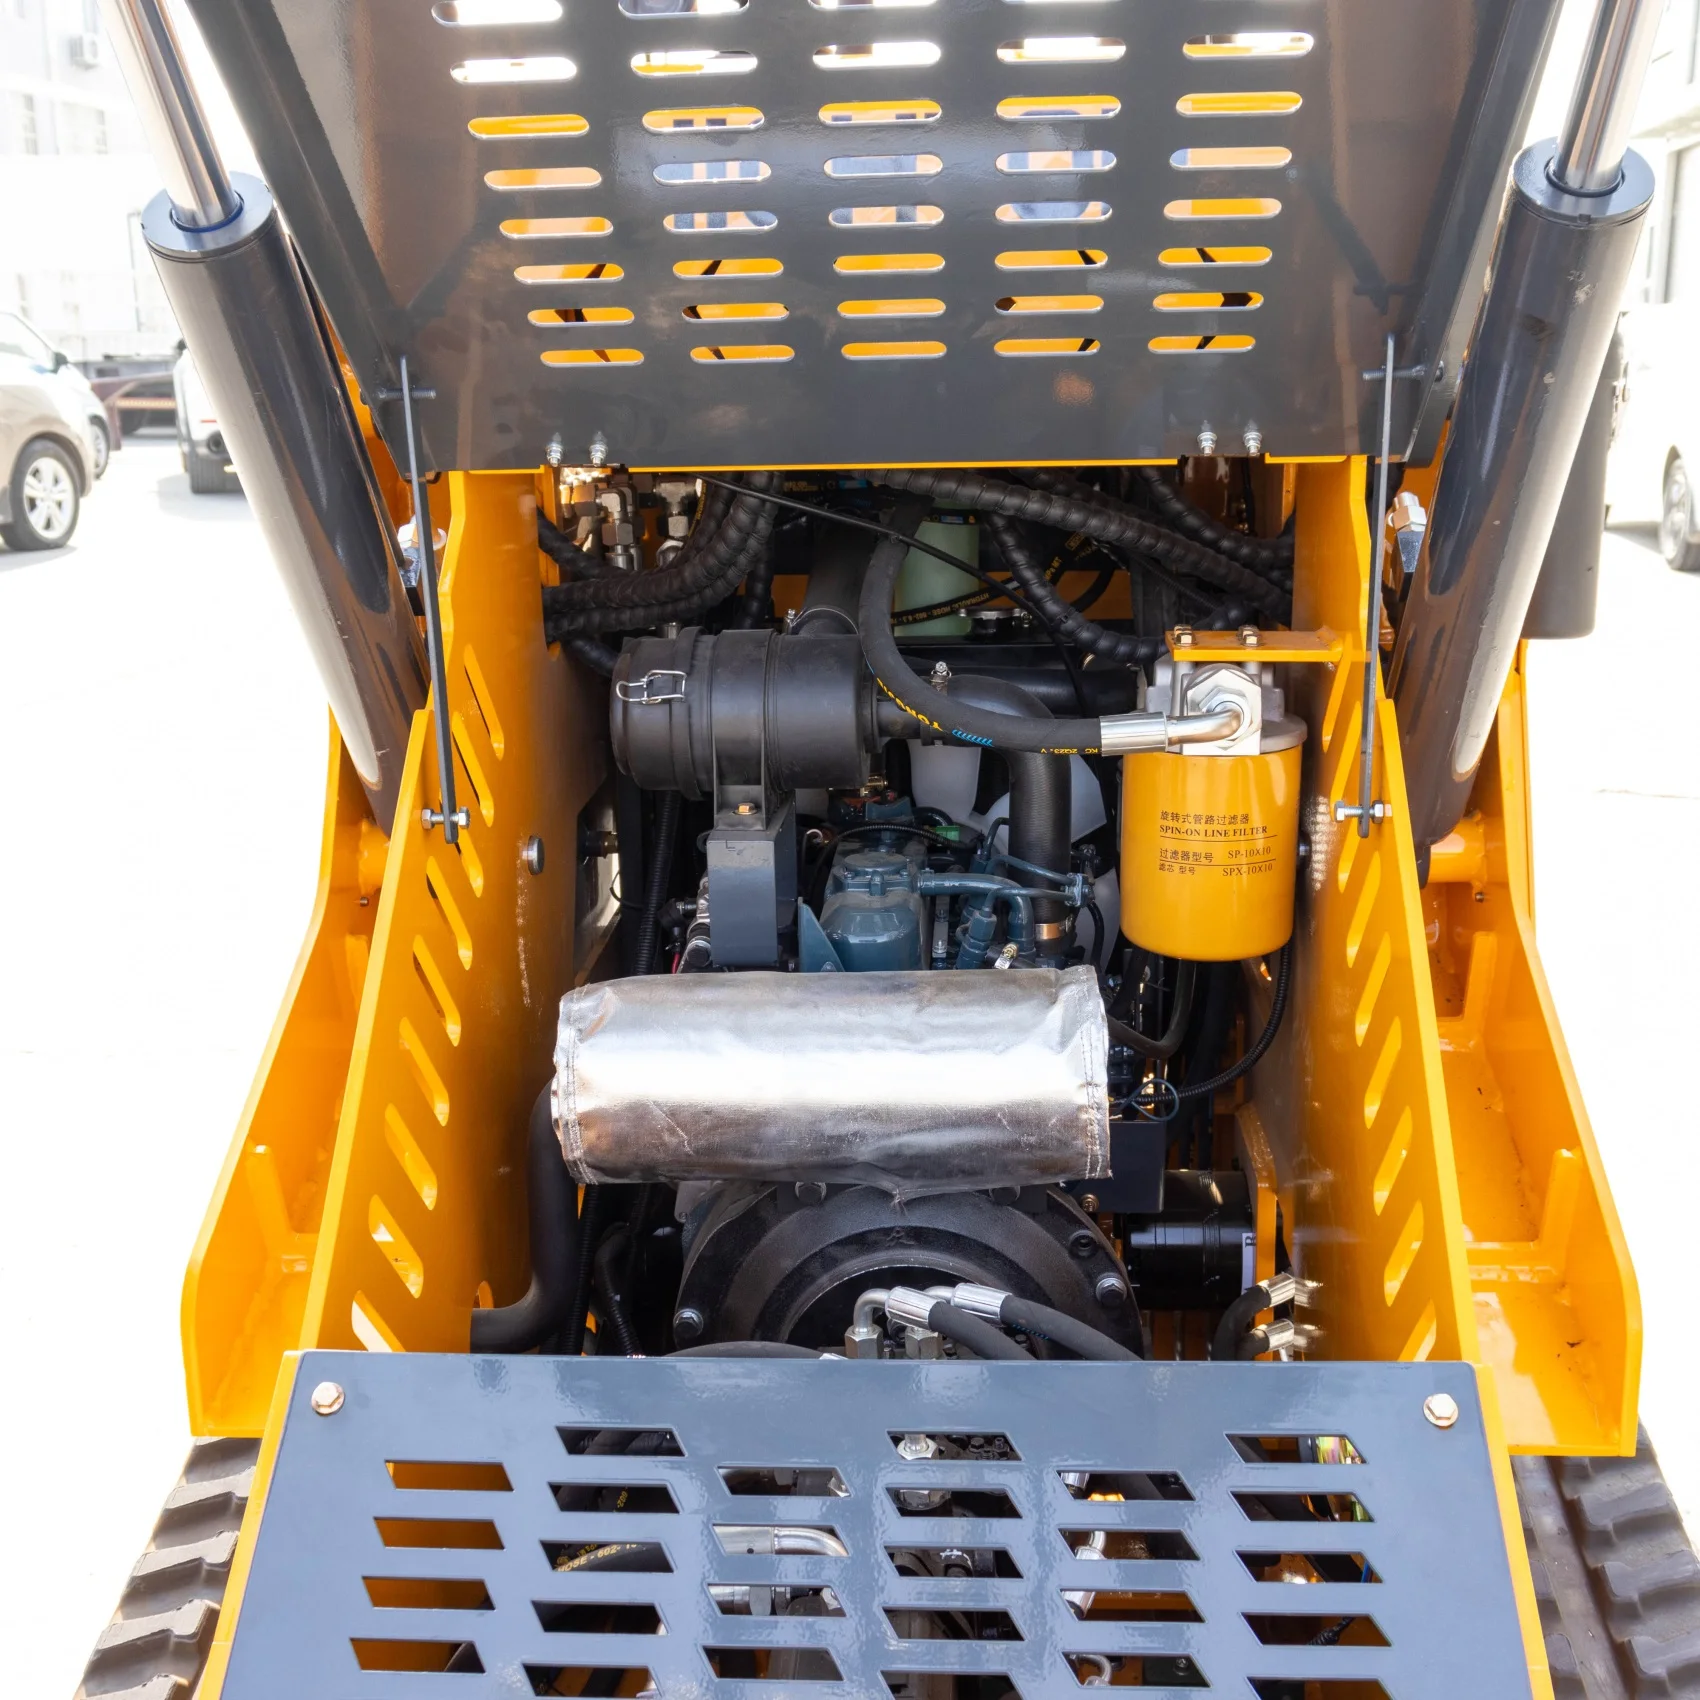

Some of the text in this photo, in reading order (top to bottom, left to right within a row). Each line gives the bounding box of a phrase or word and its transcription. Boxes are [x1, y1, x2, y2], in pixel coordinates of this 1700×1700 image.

[1160, 810, 1249, 825] 旋转式管路过滤器
[1159, 825, 1268, 838] SPIN-ON LINE FILTER
[1159, 846, 1271, 863] 过滤器型号 SP-10X10
[1223, 863, 1273, 876] SPX-10X10
